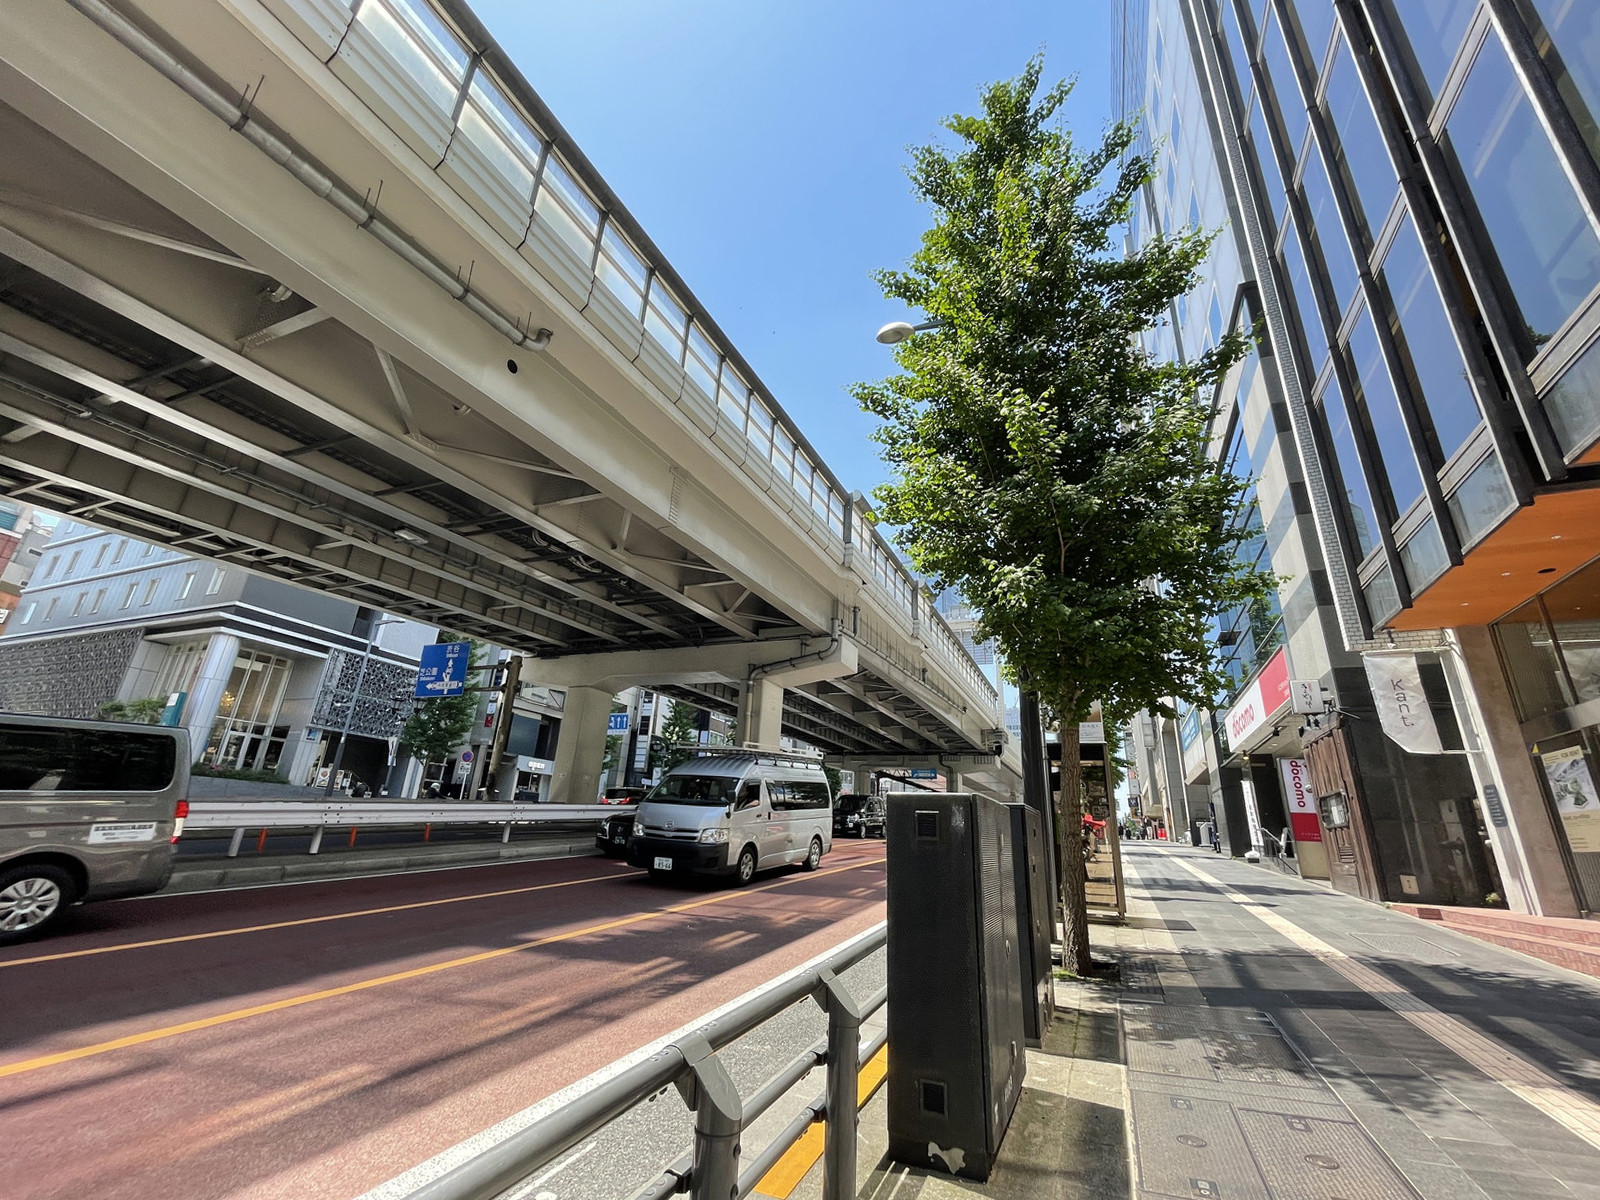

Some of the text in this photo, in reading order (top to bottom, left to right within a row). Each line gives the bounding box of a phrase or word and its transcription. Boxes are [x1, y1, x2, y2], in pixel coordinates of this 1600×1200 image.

[446, 645, 460, 653] 渋谷
[1232, 703, 1255, 738] docomo
[1290, 760, 1306, 808] docomo
